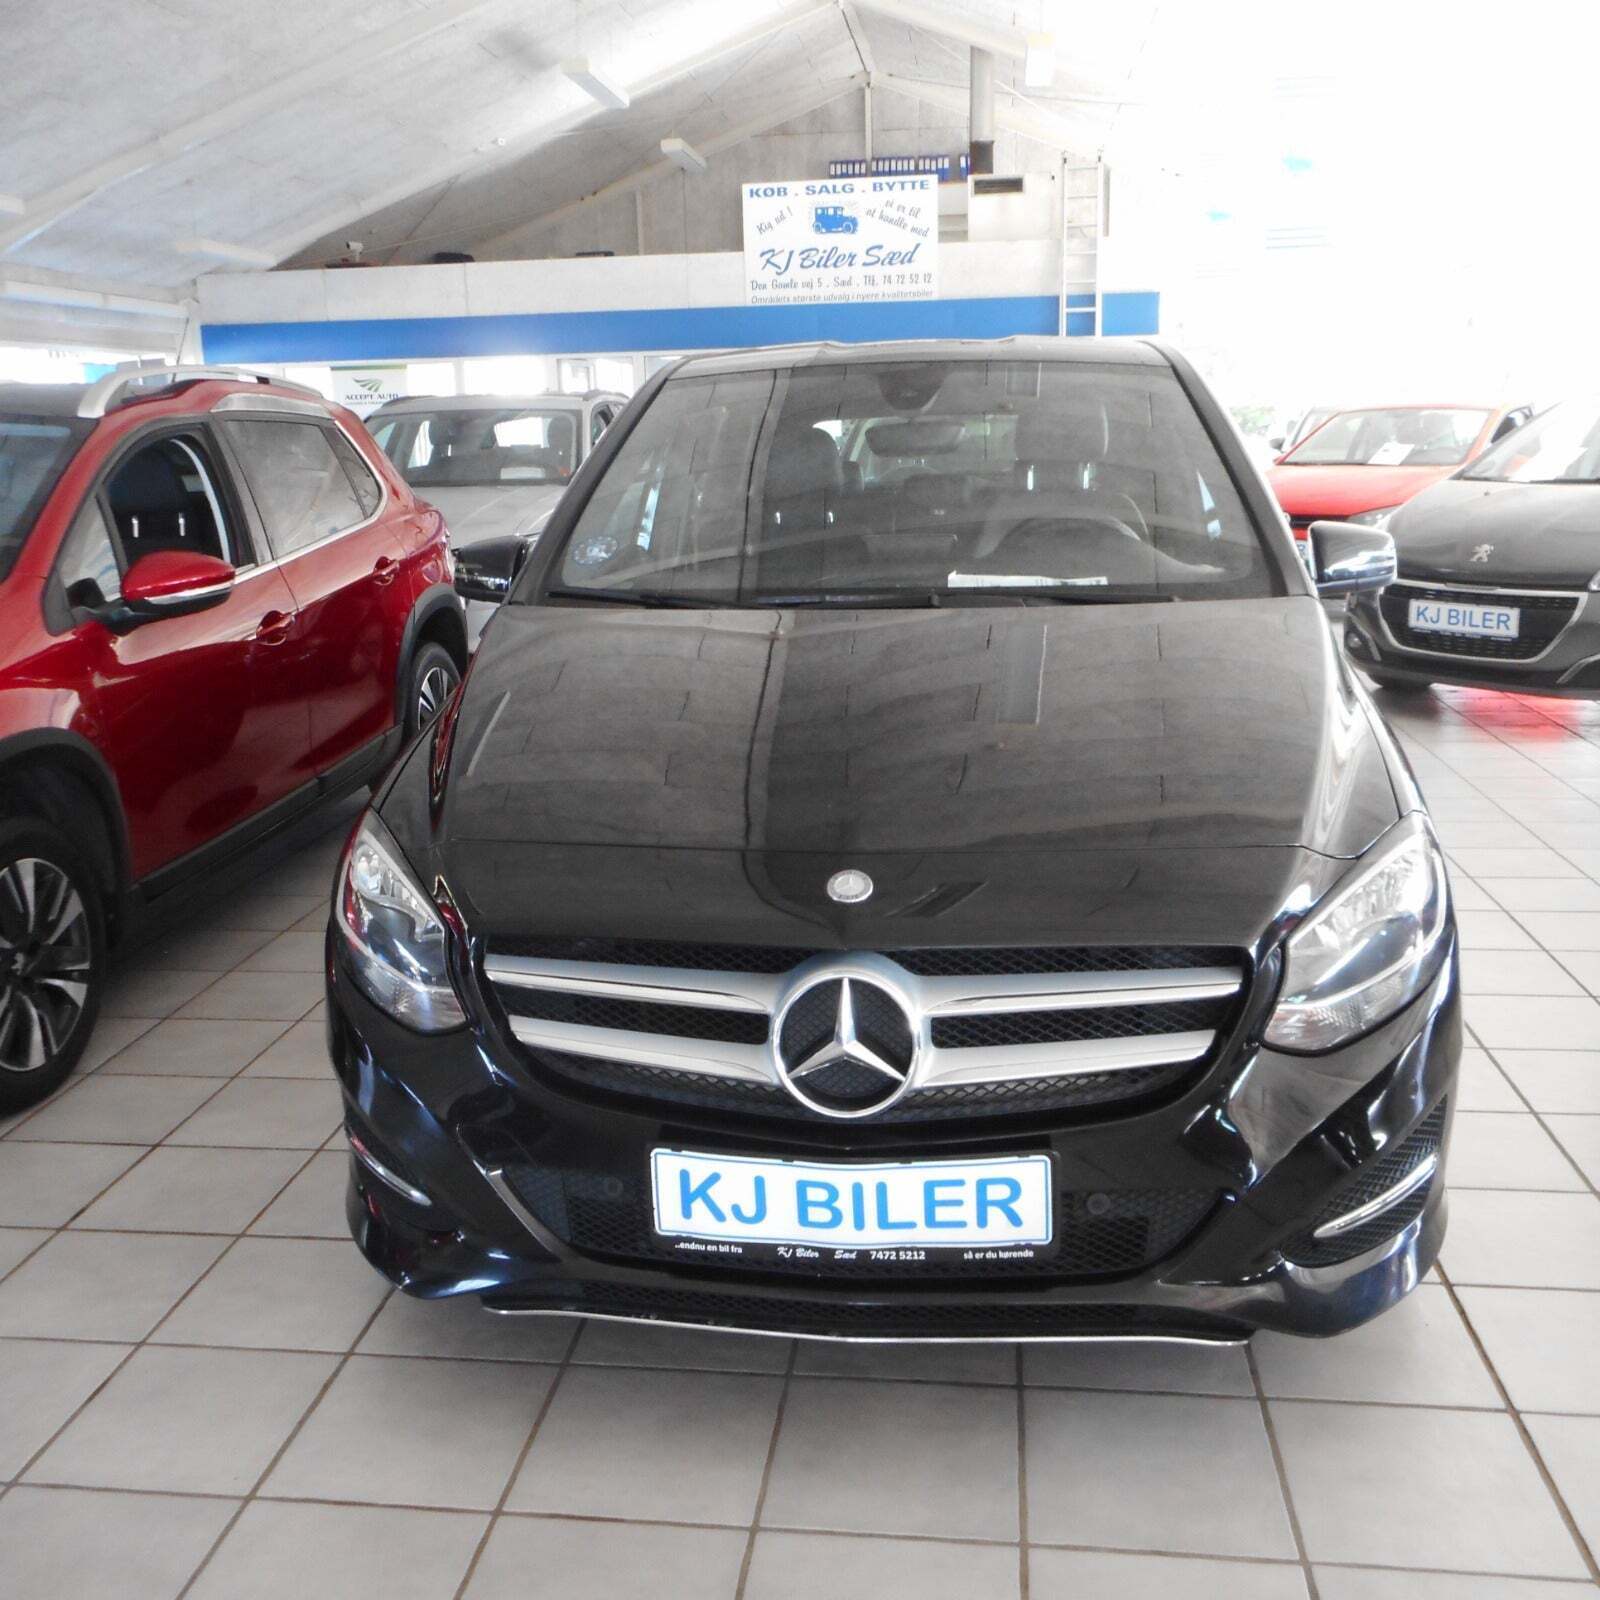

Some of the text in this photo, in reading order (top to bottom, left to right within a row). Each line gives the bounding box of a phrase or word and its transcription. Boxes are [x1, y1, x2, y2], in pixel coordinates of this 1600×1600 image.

[749, 180, 929, 198] KØB SALG BYTTE
[879, 210, 908, 230] handle
[910, 224, 930, 237] med
[760, 243, 921, 276] KJ Biler Sæd
[751, 279, 767, 291] Den
[771, 278, 799, 289] Gamle
[801, 278, 814, 291] vej
[817, 277, 824, 288] 5
[833, 275, 852, 287] Sæd
[883, 274, 892, 285] 74
[896, 274, 906, 285] 72
[909, 272, 919, 284] 52
[923, 272, 932, 283] 12
[377, 392, 399, 400] AUTO
[1416, 606, 1511, 630] KJ BILER
[679, 1168, 1024, 1231] KJ BILER
[706, 1244, 718, 1252] en
[719, 1244, 731, 1253] bil
[732, 1245, 743, 1254] fra
[777, 1246, 793, 1259] KJ
[795, 1247, 820, 1259] Biler
[870, 1251, 897, 1260] 7472
[899, 1250, 926, 1260] 5212
[963, 1249, 1034, 1260] så er du kørende
